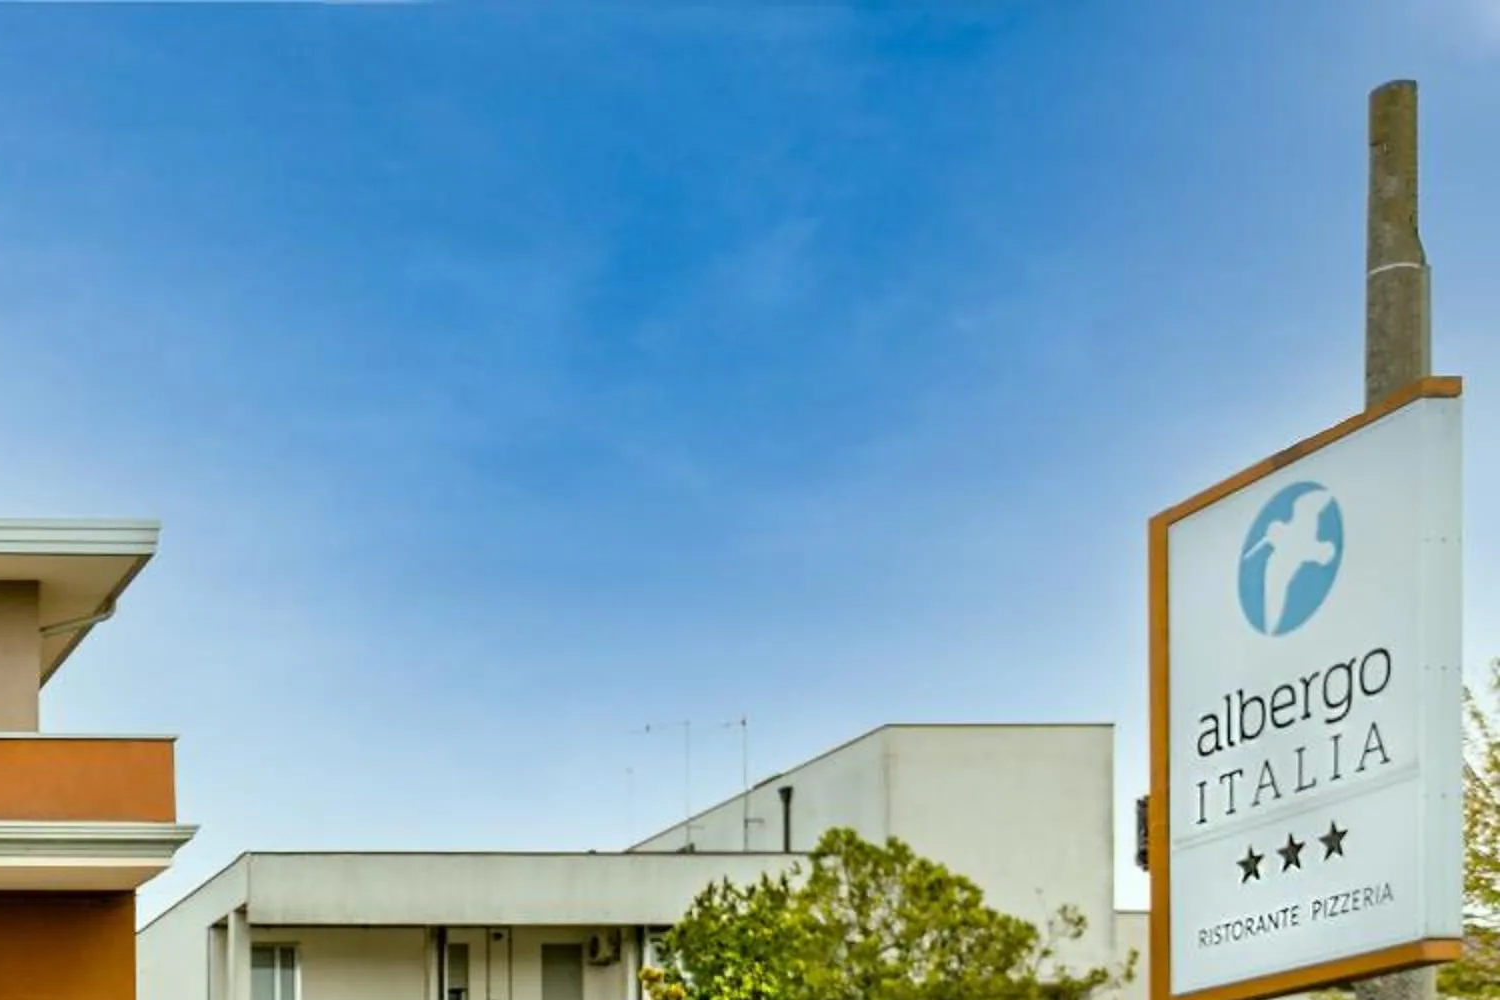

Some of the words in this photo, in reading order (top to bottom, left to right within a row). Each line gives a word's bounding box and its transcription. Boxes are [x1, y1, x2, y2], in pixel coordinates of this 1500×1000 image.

[1196, 647, 1392, 758] albergo
[1195, 721, 1391, 826] ITALIA
[1198, 905, 1300, 947] RISTORANTE
[1311, 882, 1393, 921] PIZZERIA
